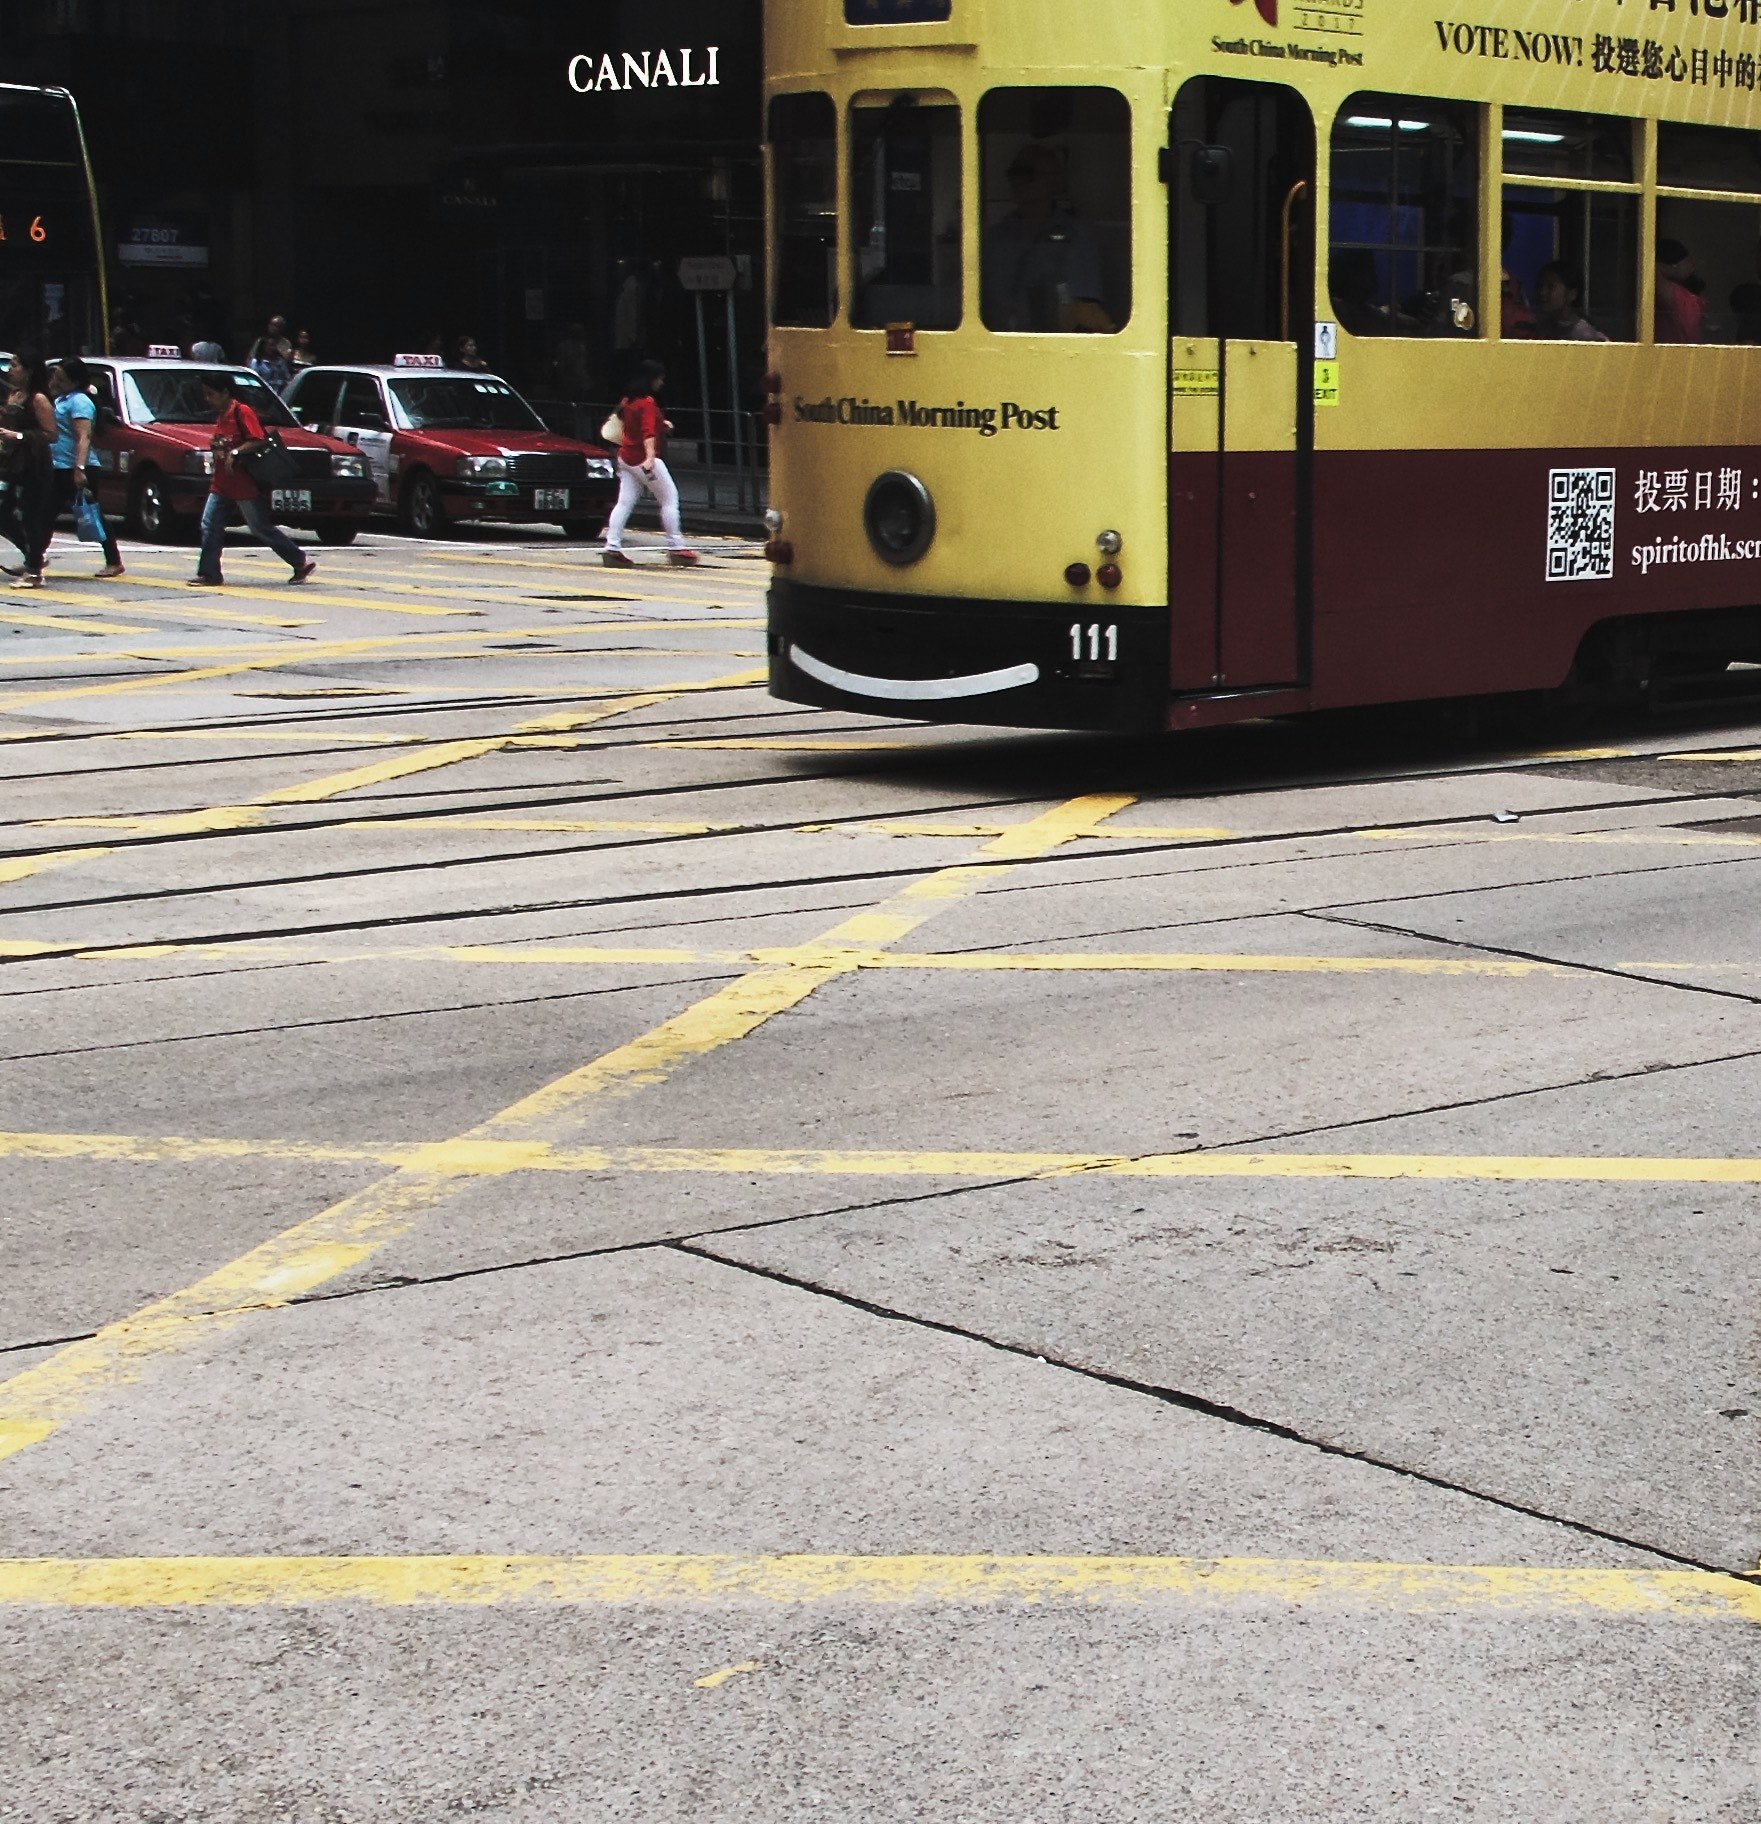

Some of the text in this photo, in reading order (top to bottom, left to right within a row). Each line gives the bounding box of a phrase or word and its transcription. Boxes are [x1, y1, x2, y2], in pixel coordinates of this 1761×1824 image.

[1434, 20, 1511, 60] VOTE
[1513, 30, 1584, 67] NOW!
[567, 46, 721, 94] CANALI
[1338, 48, 1363, 66] Post
[30, 216, 46, 242] 6
[154, 347, 180, 356] TAXI
[402, 355, 440, 366] TAXI
[1314, 388, 1338, 401] EXIT
[794, 396, 1060, 438] South China Morning Post
[1067, 623, 1118, 663] 111
